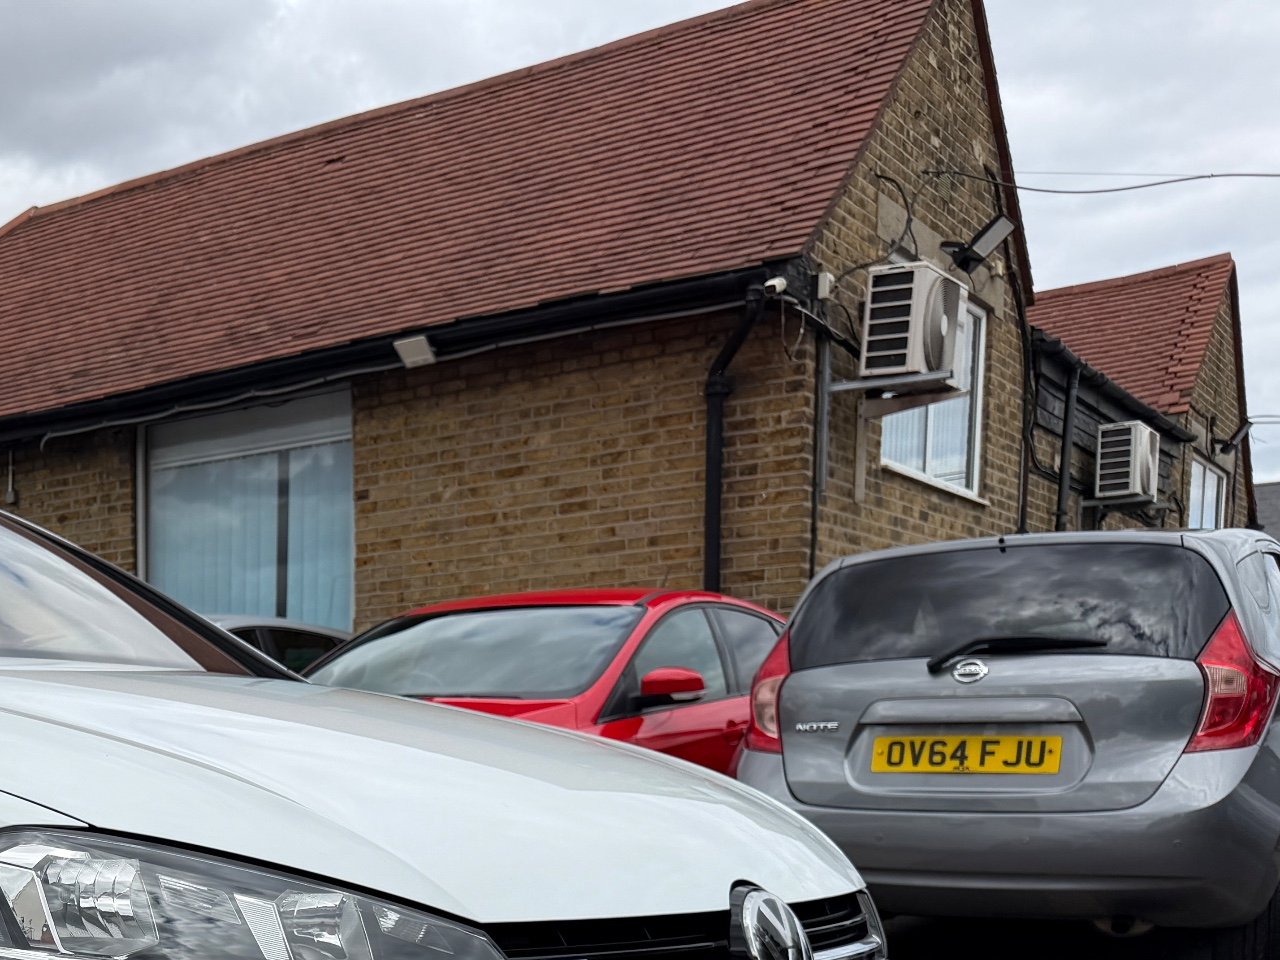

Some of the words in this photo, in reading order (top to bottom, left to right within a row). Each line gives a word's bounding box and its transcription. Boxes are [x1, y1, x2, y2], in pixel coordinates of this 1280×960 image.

[796, 722, 840, 732] NOTE
[886, 741, 968, 767] OV64
[979, 741, 1047, 767] FJU
